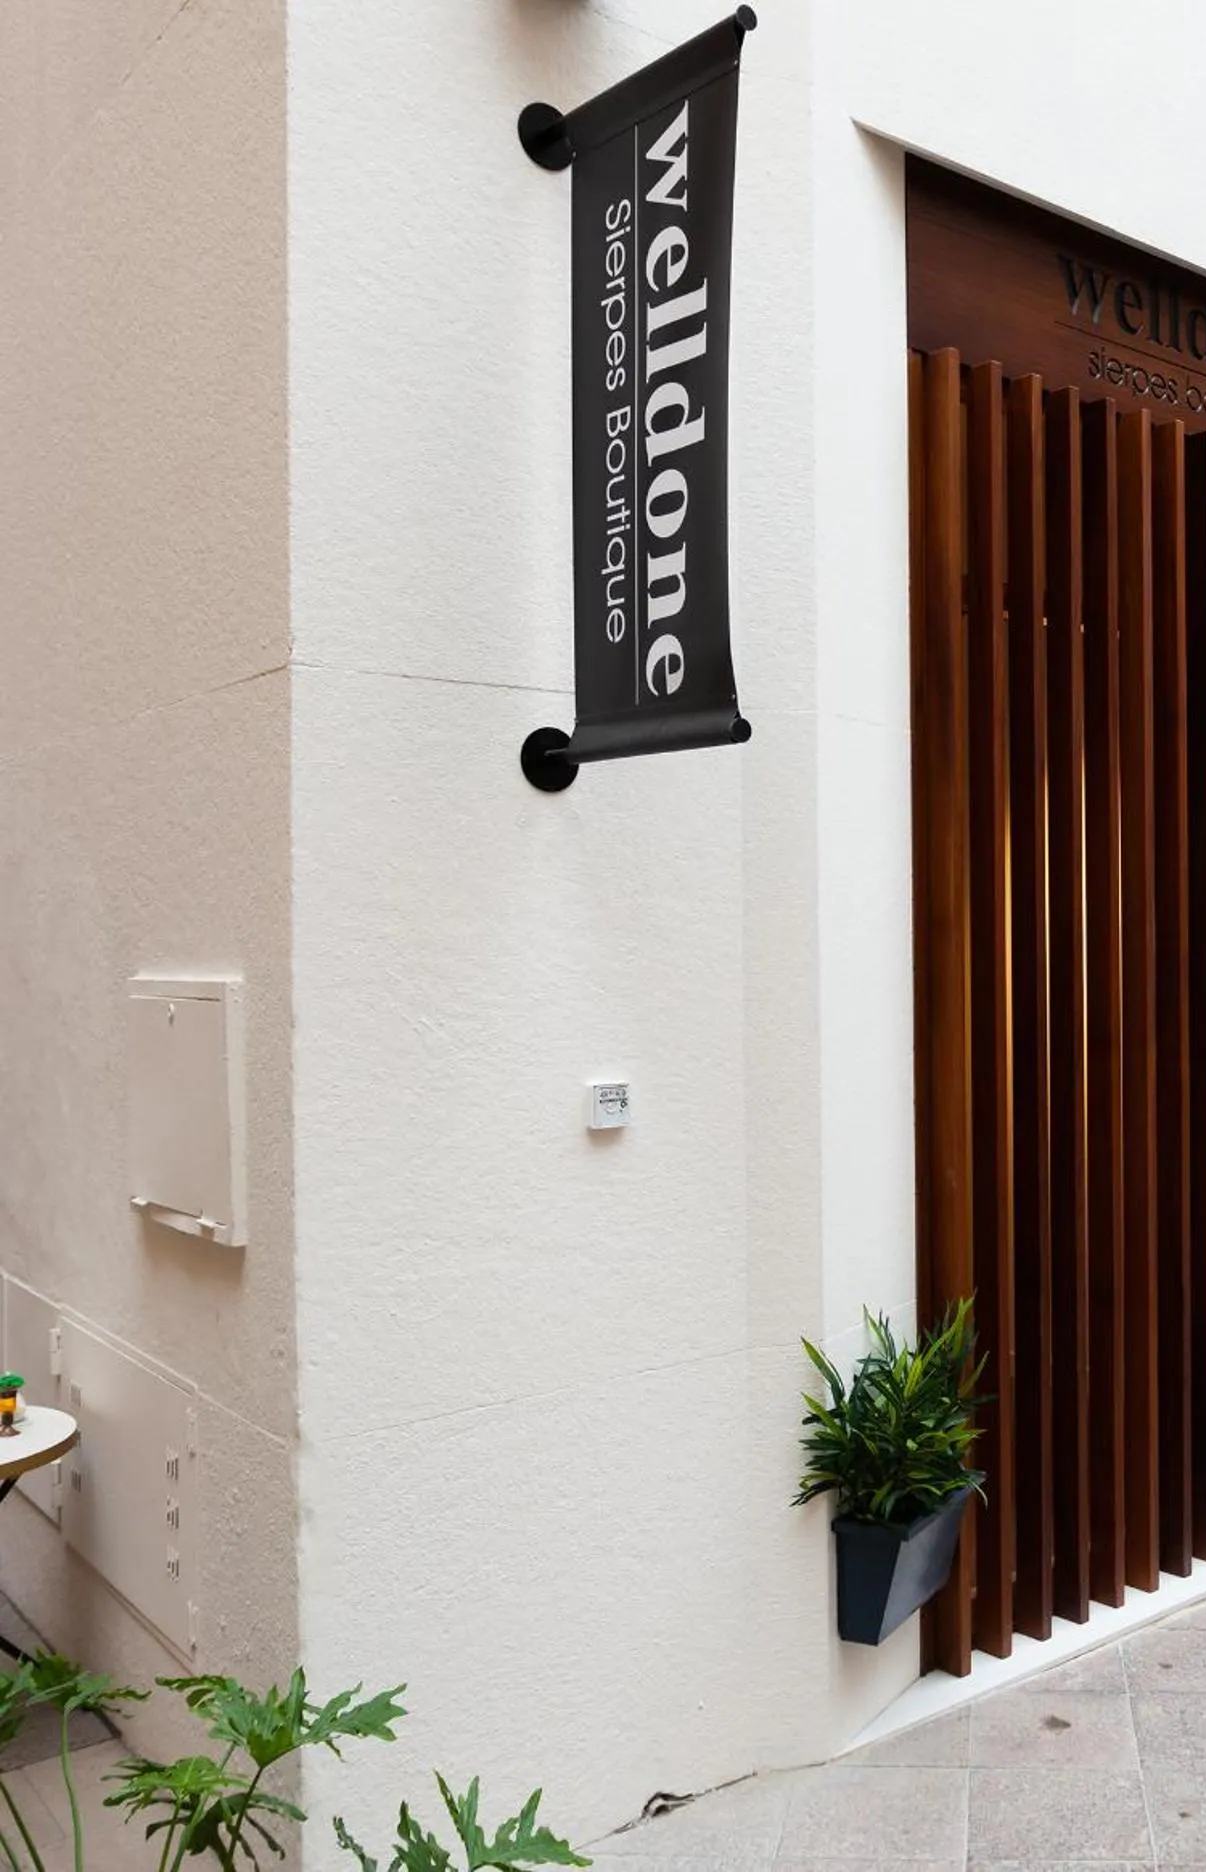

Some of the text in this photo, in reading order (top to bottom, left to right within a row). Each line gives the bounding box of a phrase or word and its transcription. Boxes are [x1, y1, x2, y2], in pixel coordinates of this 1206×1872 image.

[601, 198, 632, 643] Sierpes Boutique
[645, 99, 708, 697] welldone
[1088, 346, 1179, 405] sierpes
